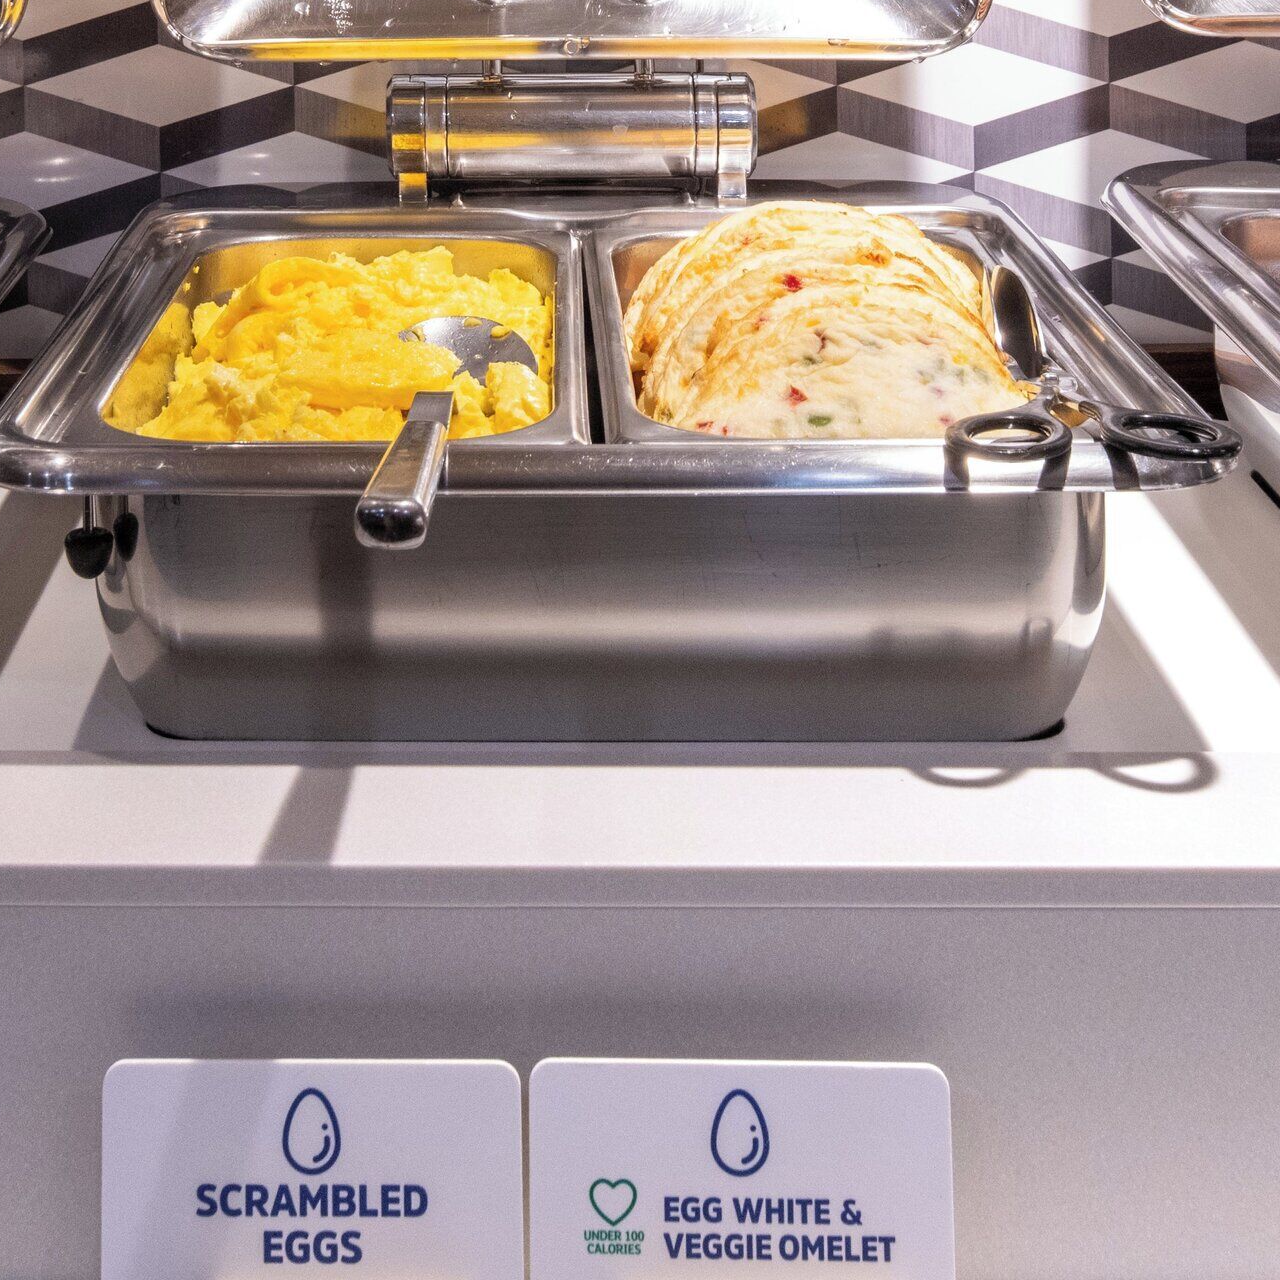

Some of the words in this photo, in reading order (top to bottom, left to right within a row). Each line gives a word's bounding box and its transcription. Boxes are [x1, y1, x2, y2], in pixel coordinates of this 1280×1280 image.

[196, 1183, 428, 1217] SCRAMBLED
[663, 1196, 722, 1223] EGG
[733, 1197, 830, 1225] WHITE
[840, 1199, 863, 1226] &
[263, 1230, 363, 1264] EGGS
[583, 1229, 622, 1241] UNDER
[625, 1230, 645, 1241] 100
[587, 1243, 642, 1255] CALORIES
[663, 1232, 772, 1260] VEGGIE
[779, 1234, 896, 1262] OMELET
